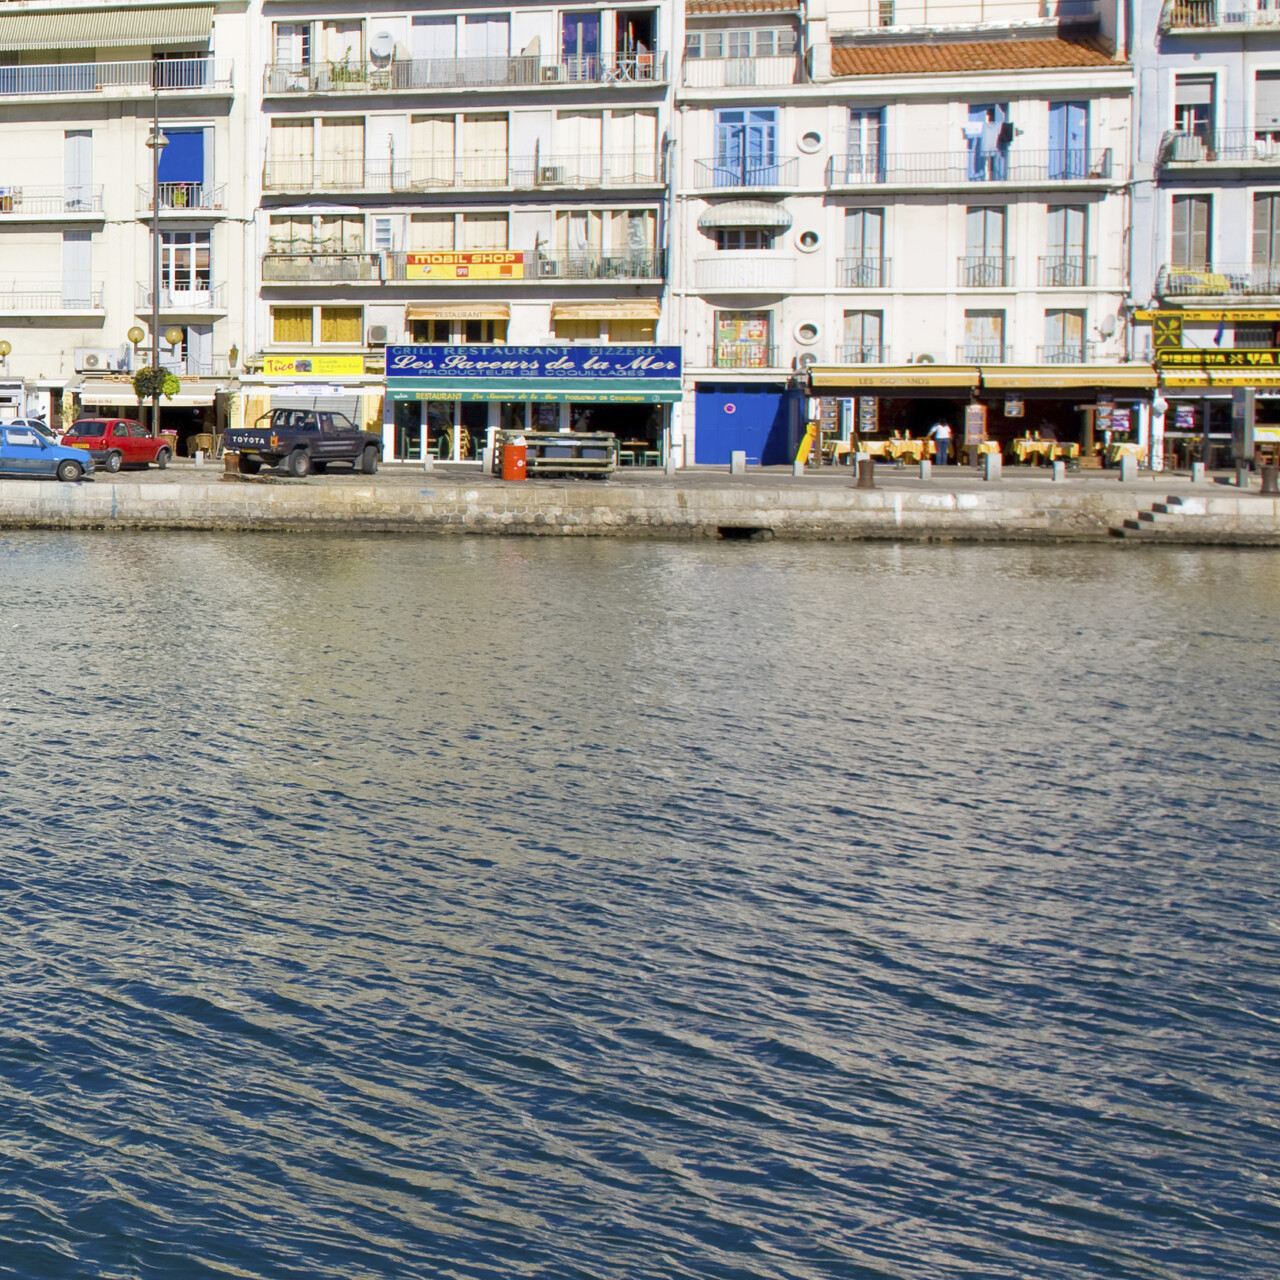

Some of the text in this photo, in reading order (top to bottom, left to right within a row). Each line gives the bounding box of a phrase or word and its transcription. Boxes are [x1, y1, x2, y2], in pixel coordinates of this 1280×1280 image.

[415, 254, 515, 263] MOBIL SHOP
[457, 267, 468, 276] SFR
[392, 346, 663, 356] GRILL RESTAURANT PIZZERIA
[390, 355, 676, 370] Les Saveurs de la Mer
[1247, 353, 1274, 365] VA
[858, 377, 874, 385] LES
[415, 392, 462, 400] RESTAURANT
[232, 436, 265, 444] TOYOTA
